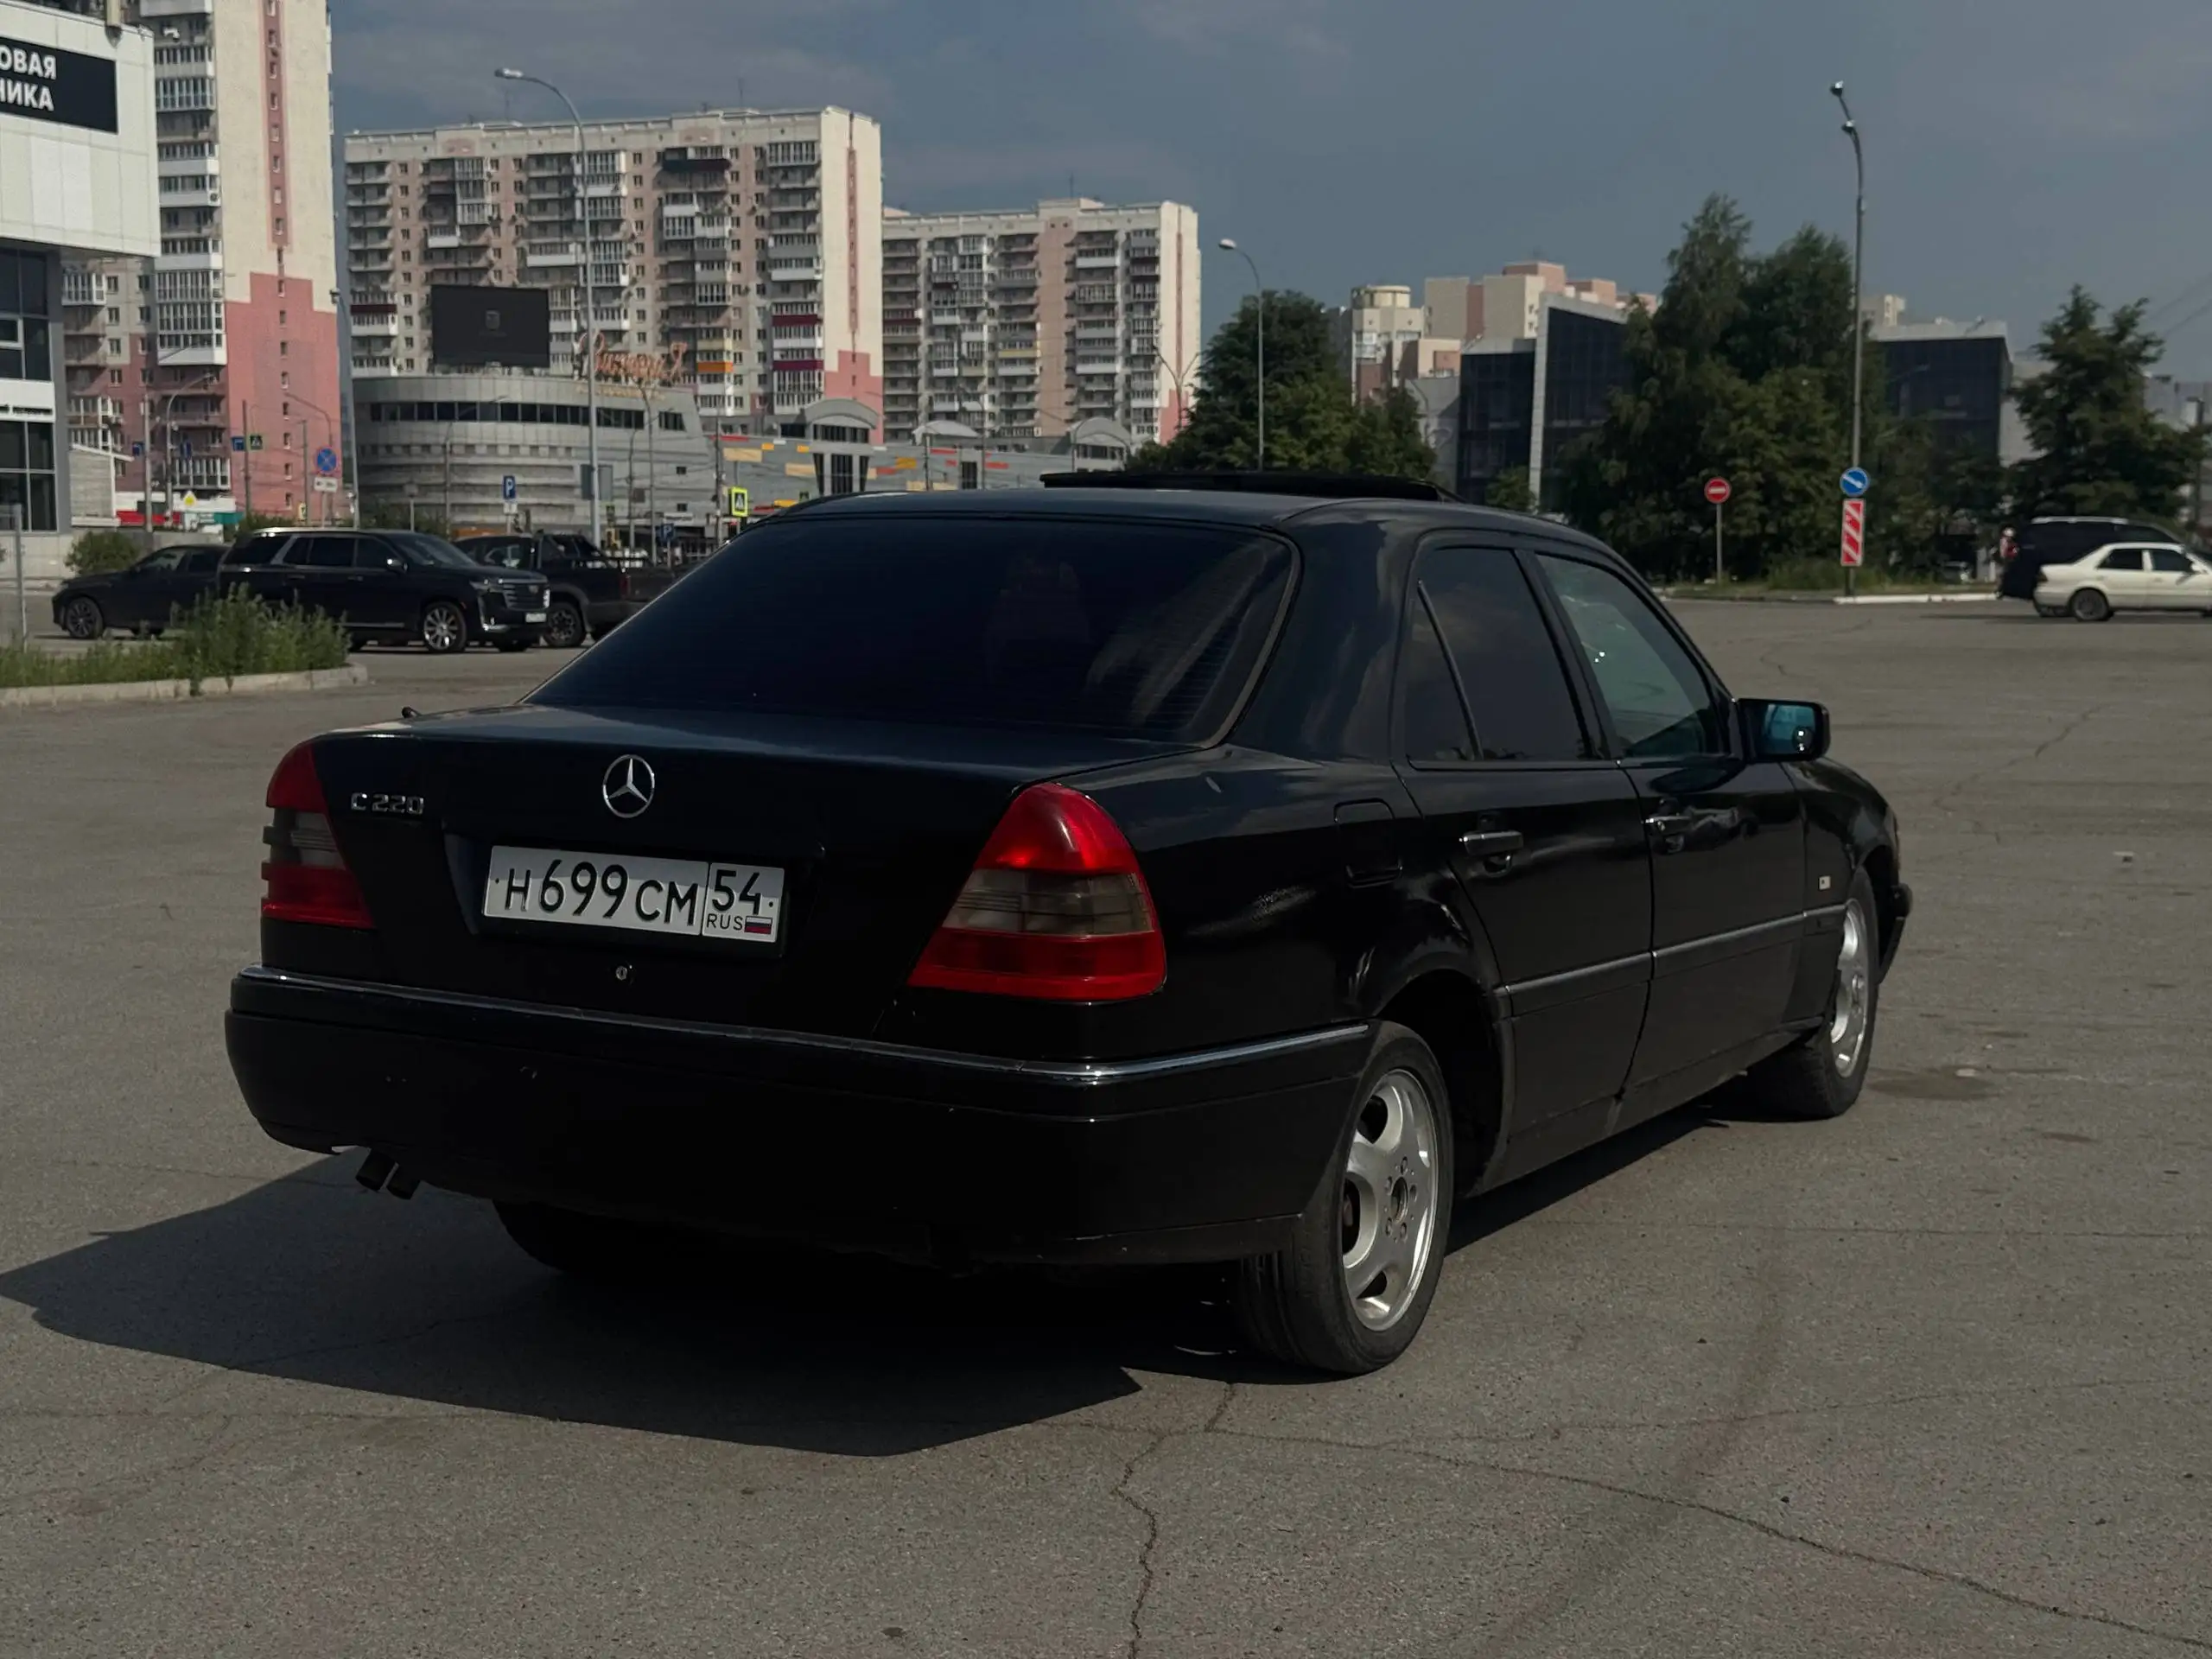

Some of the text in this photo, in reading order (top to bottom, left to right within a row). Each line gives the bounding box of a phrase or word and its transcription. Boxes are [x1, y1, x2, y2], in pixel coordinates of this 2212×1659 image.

[0, 45, 56, 79] ОВАЯ
[505, 478, 513, 497] P
[352, 792, 423, 814] C 220
[712, 869, 761, 916] 54
[706, 912, 743, 931] RUS
